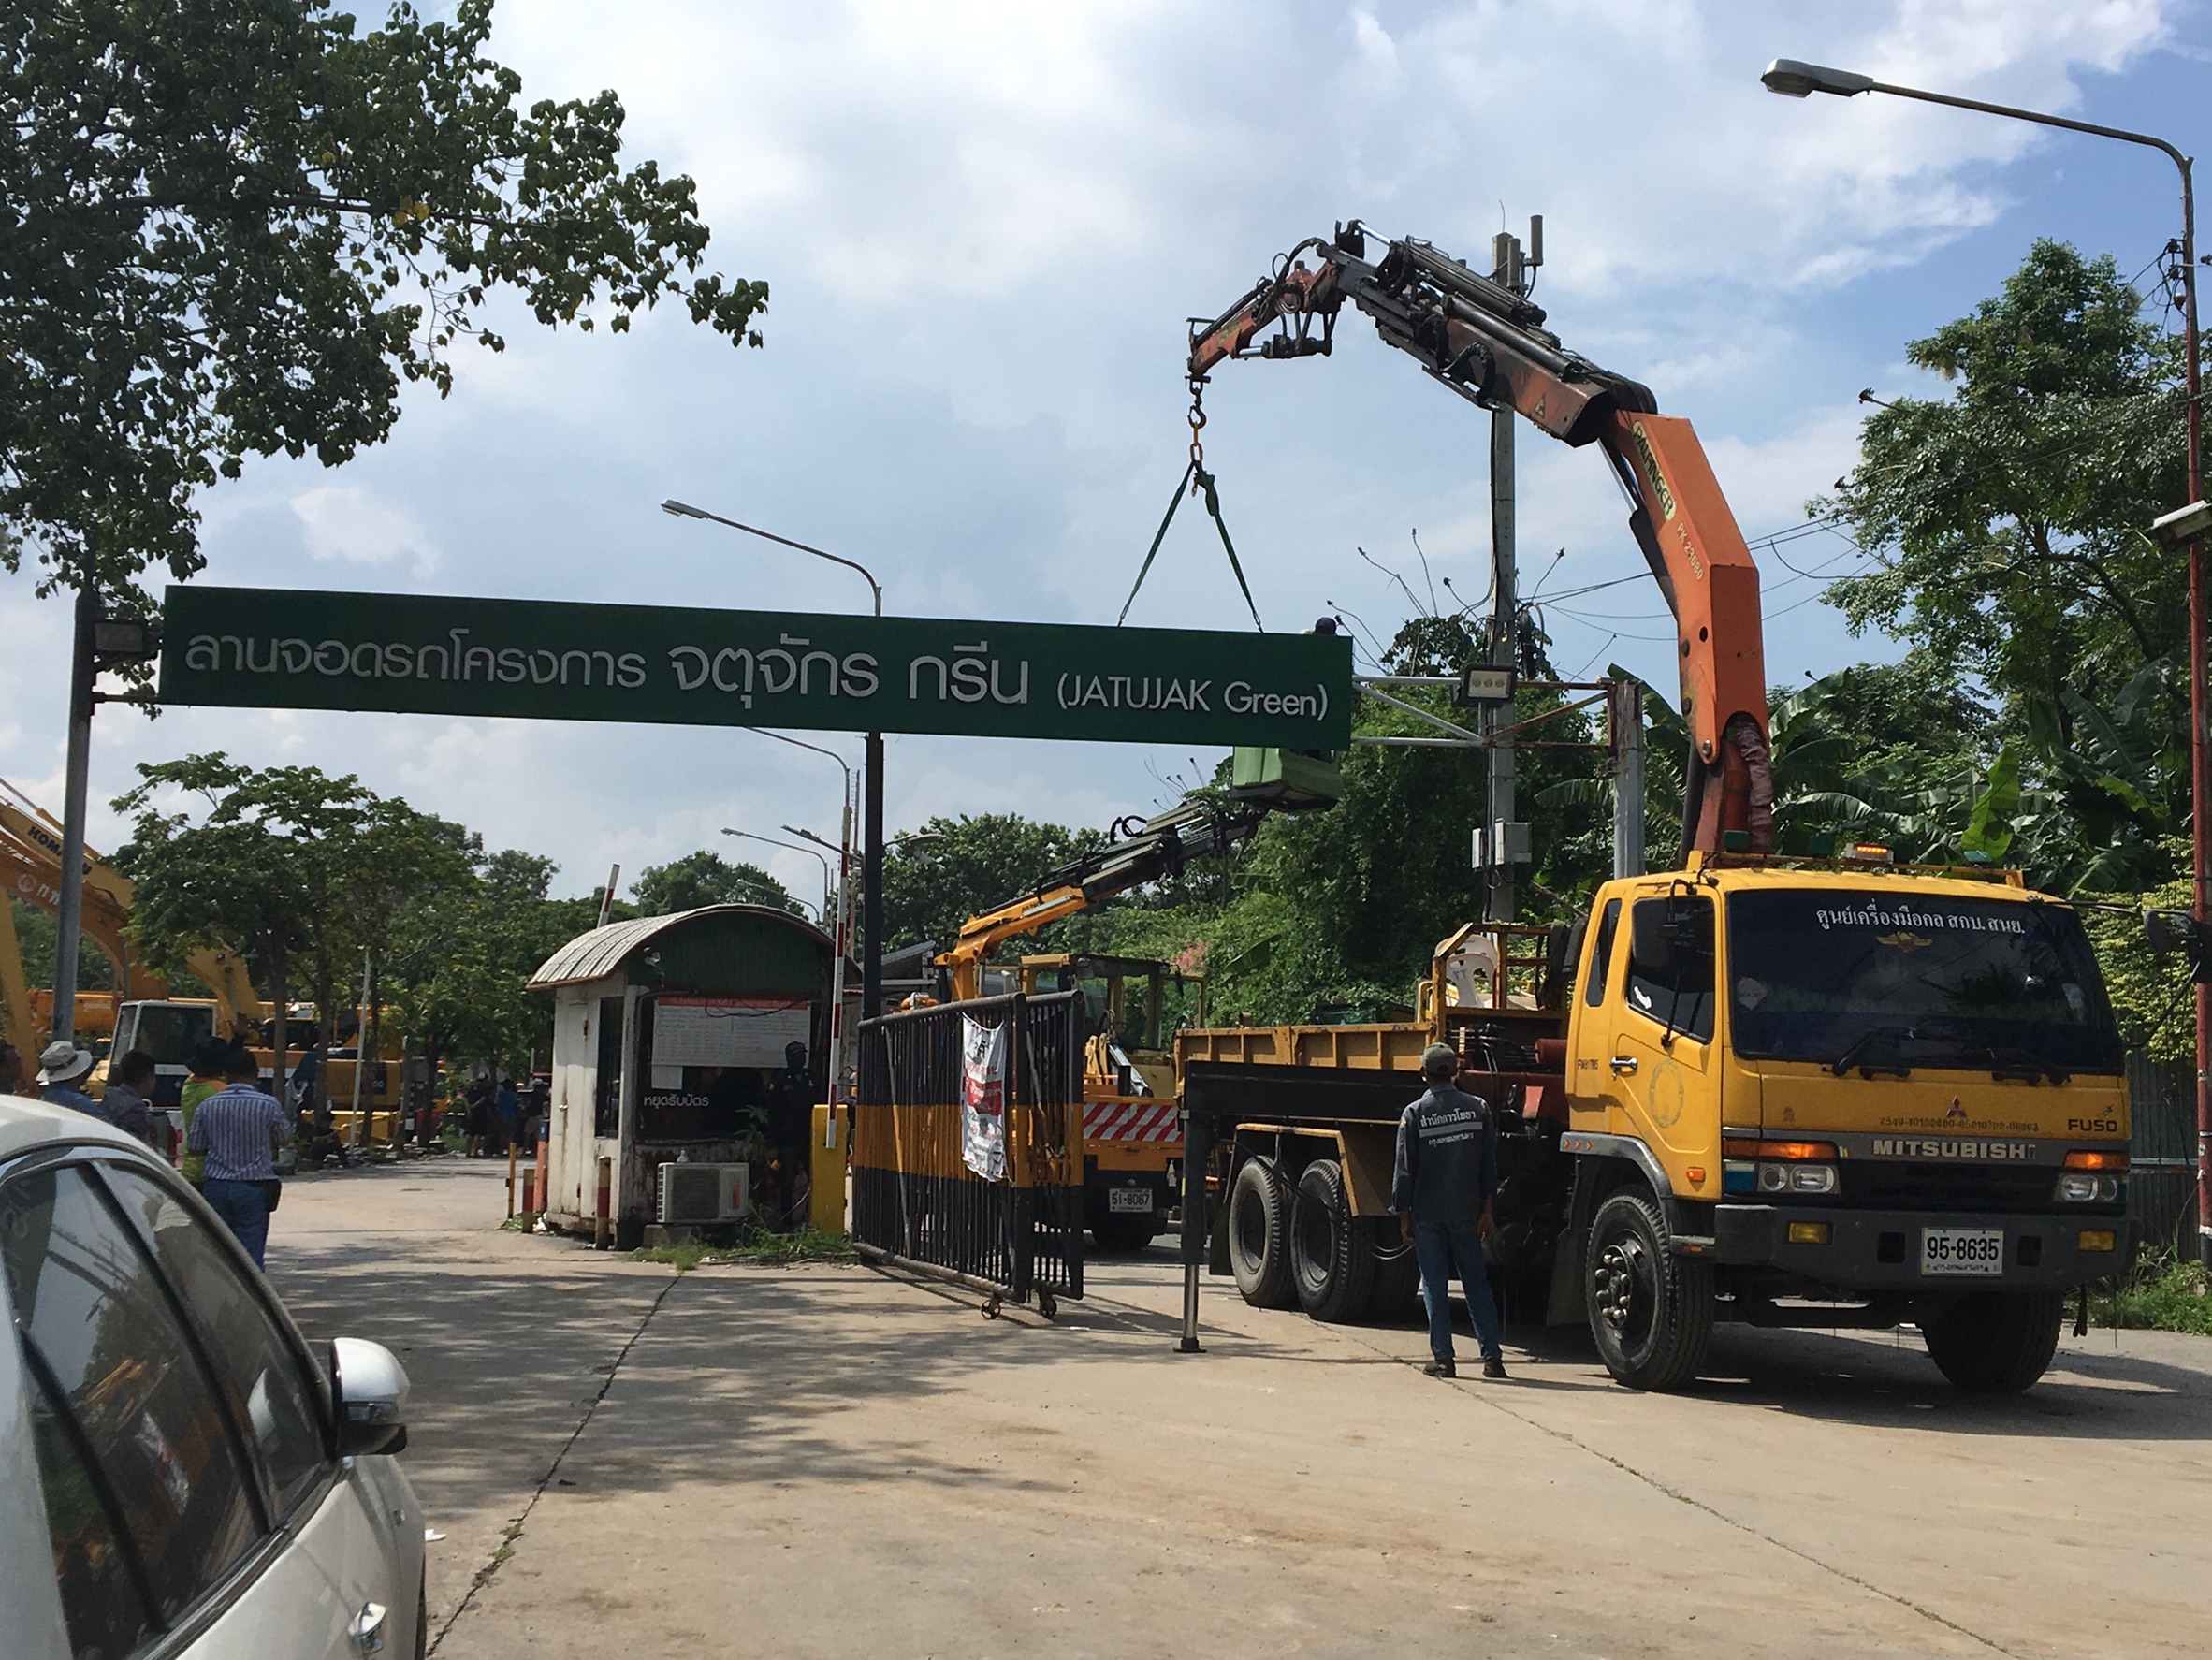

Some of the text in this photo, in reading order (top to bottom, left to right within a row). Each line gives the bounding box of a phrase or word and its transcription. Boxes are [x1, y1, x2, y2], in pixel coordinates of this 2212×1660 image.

[185, 628, 1028, 710] ลานจอดรถโครงการ จตุจักร กรีน
[1057, 671, 1330, 721] (JATUJAK Green)
[1816, 898, 2026, 934] ศูนย์เครื่องมือกล สกบ. สนย.
[643, 1093, 710, 1110] หยุดรับบัตร
[2067, 1118, 2118, 1132] FUSO
[1927, 1236, 2000, 1261] 95-8635
